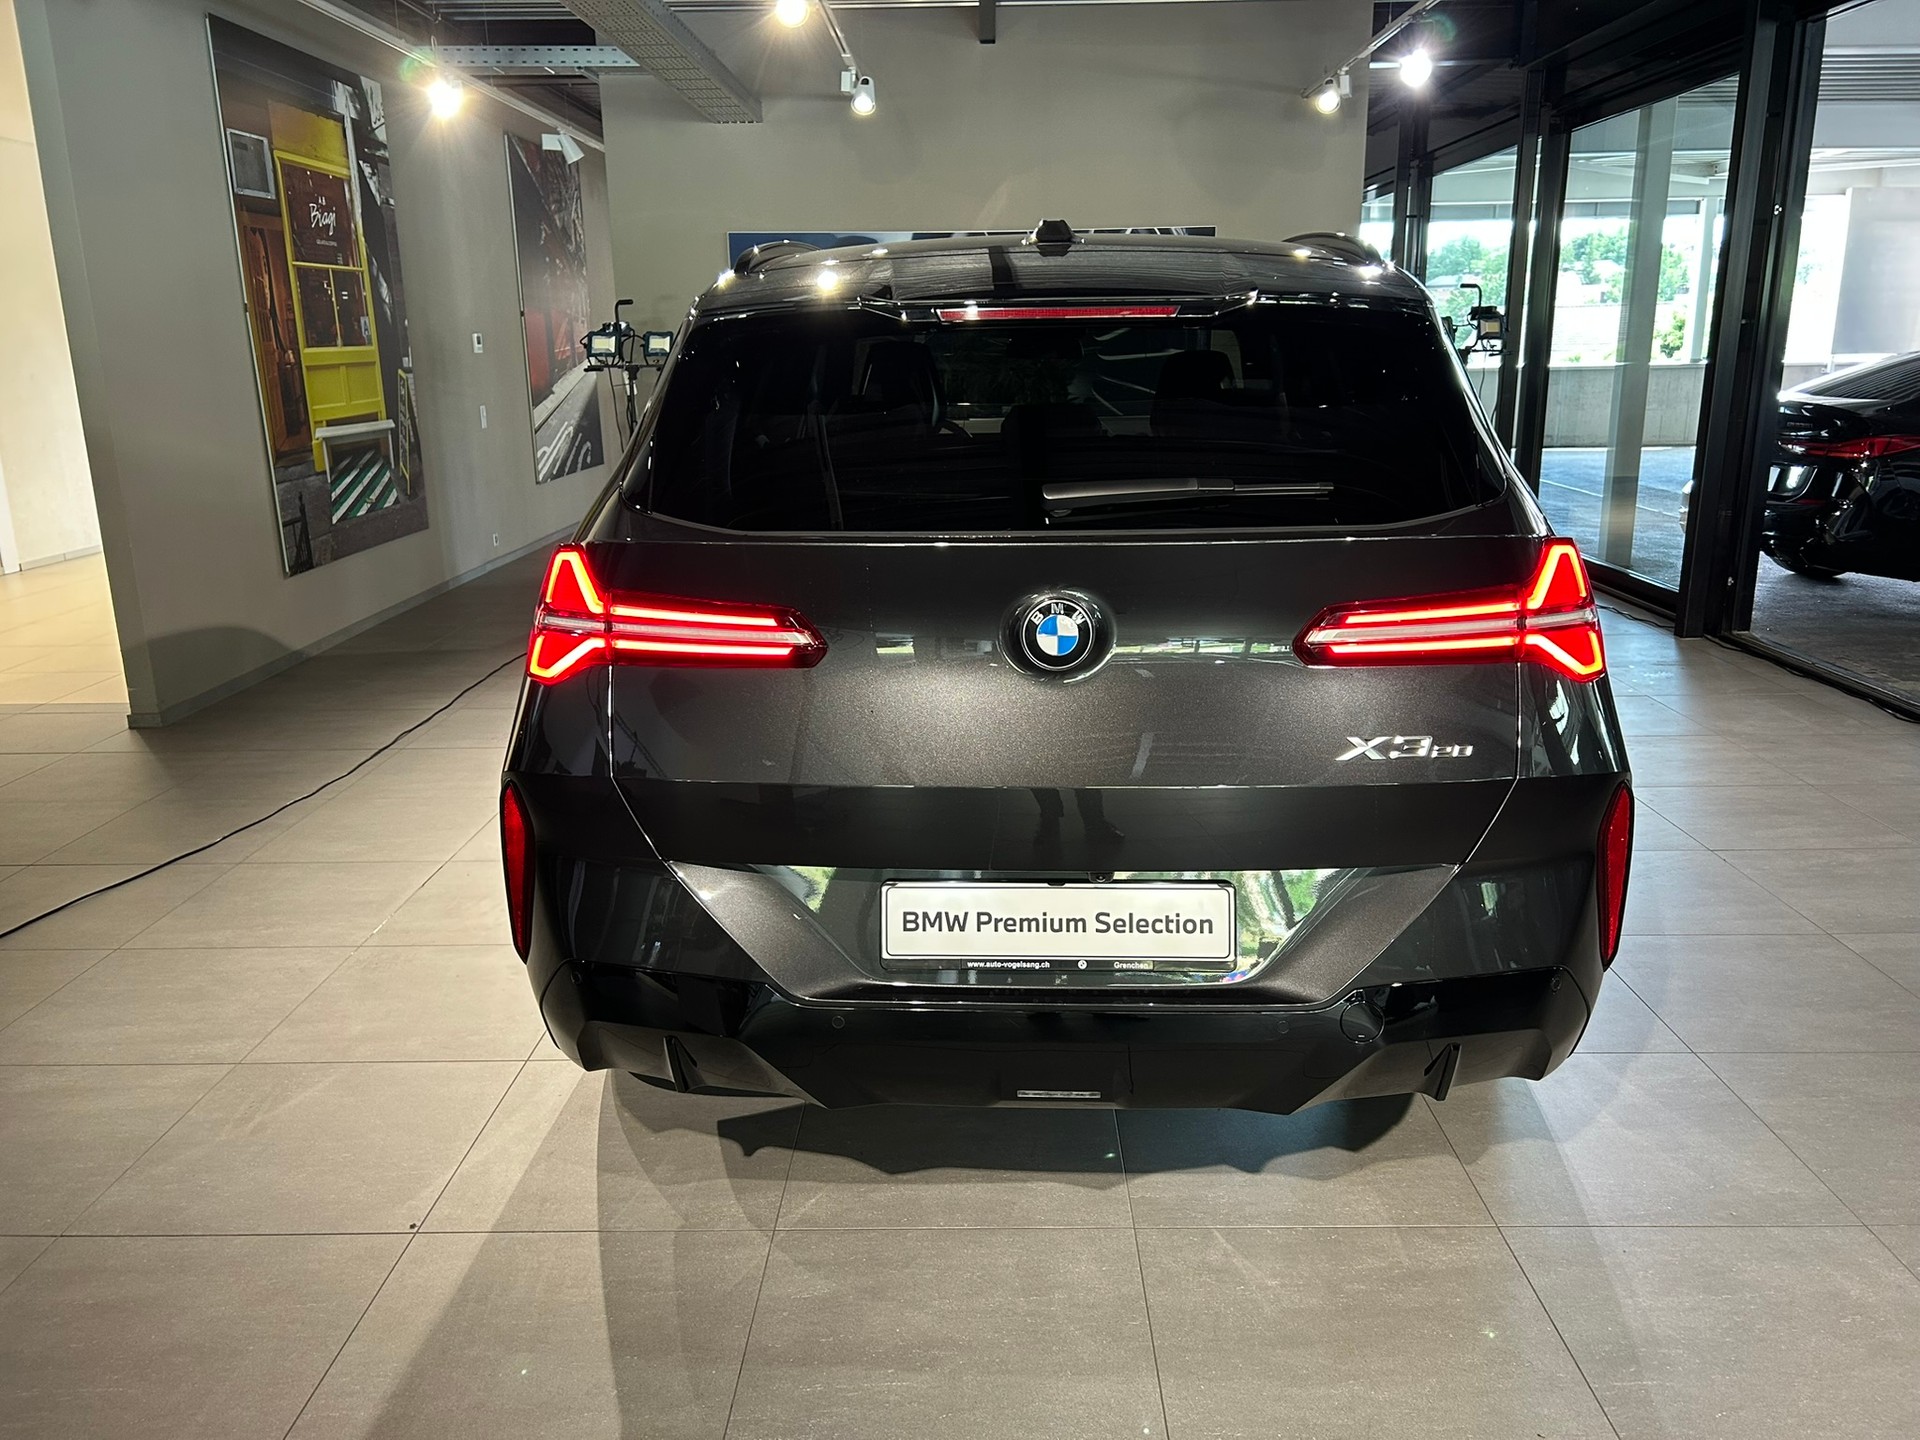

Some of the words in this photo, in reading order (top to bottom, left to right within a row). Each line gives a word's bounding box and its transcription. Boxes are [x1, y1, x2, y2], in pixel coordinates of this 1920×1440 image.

[309, 204, 336, 236] Biagi
[1030, 602, 1087, 625] BMW
[902, 911, 969, 933] BMW
[976, 912, 1087, 934] Premium
[1095, 912, 1214, 935] Selection
[967, 960, 1050, 970] www.auto-vogelsang.ch
